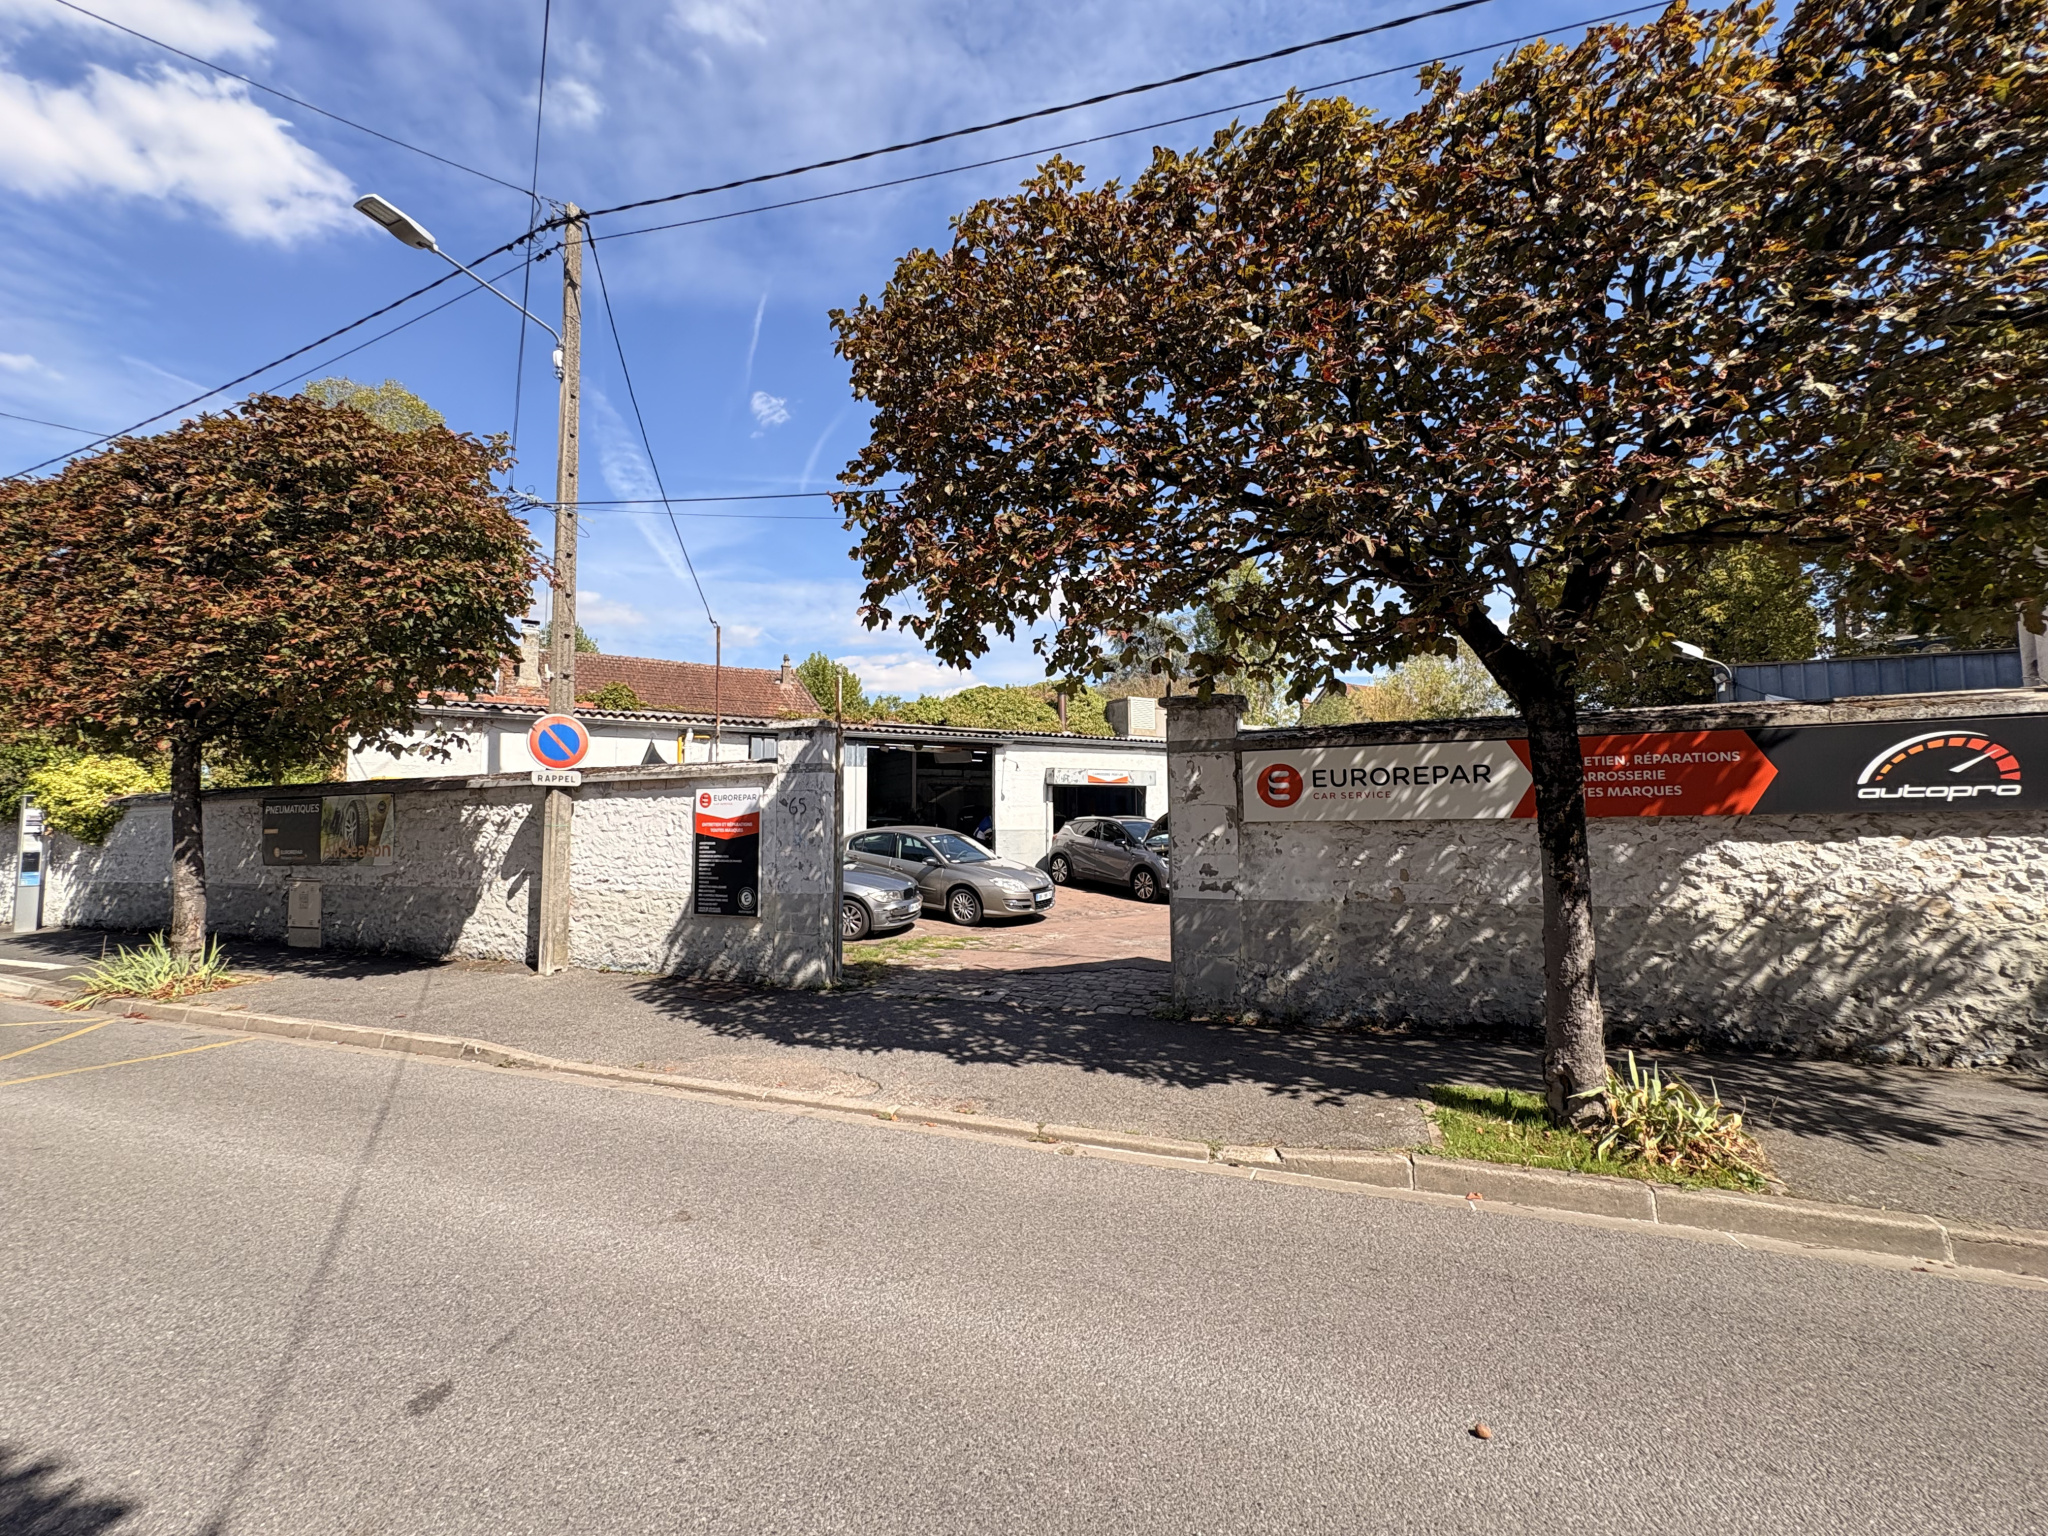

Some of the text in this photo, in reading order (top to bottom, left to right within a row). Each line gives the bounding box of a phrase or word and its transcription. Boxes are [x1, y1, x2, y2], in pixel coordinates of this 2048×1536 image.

[1583, 751, 1741, 767] ETIEN, RÉPARATIONS
[537, 774, 576, 783] RAPPEL
[1312, 764, 1491, 787] EUROREPAR
[1582, 769, 1666, 782] RROSSERIE
[713, 793, 758, 802] EUROREPAR
[1313, 790, 1392, 800] CAR SERVICE
[1607, 785, 1683, 798] MARQUES
[1857, 784, 2022, 802] autopro
[265, 803, 320, 815] PNEUMATIQUES
[789, 797, 806, 815] 65
